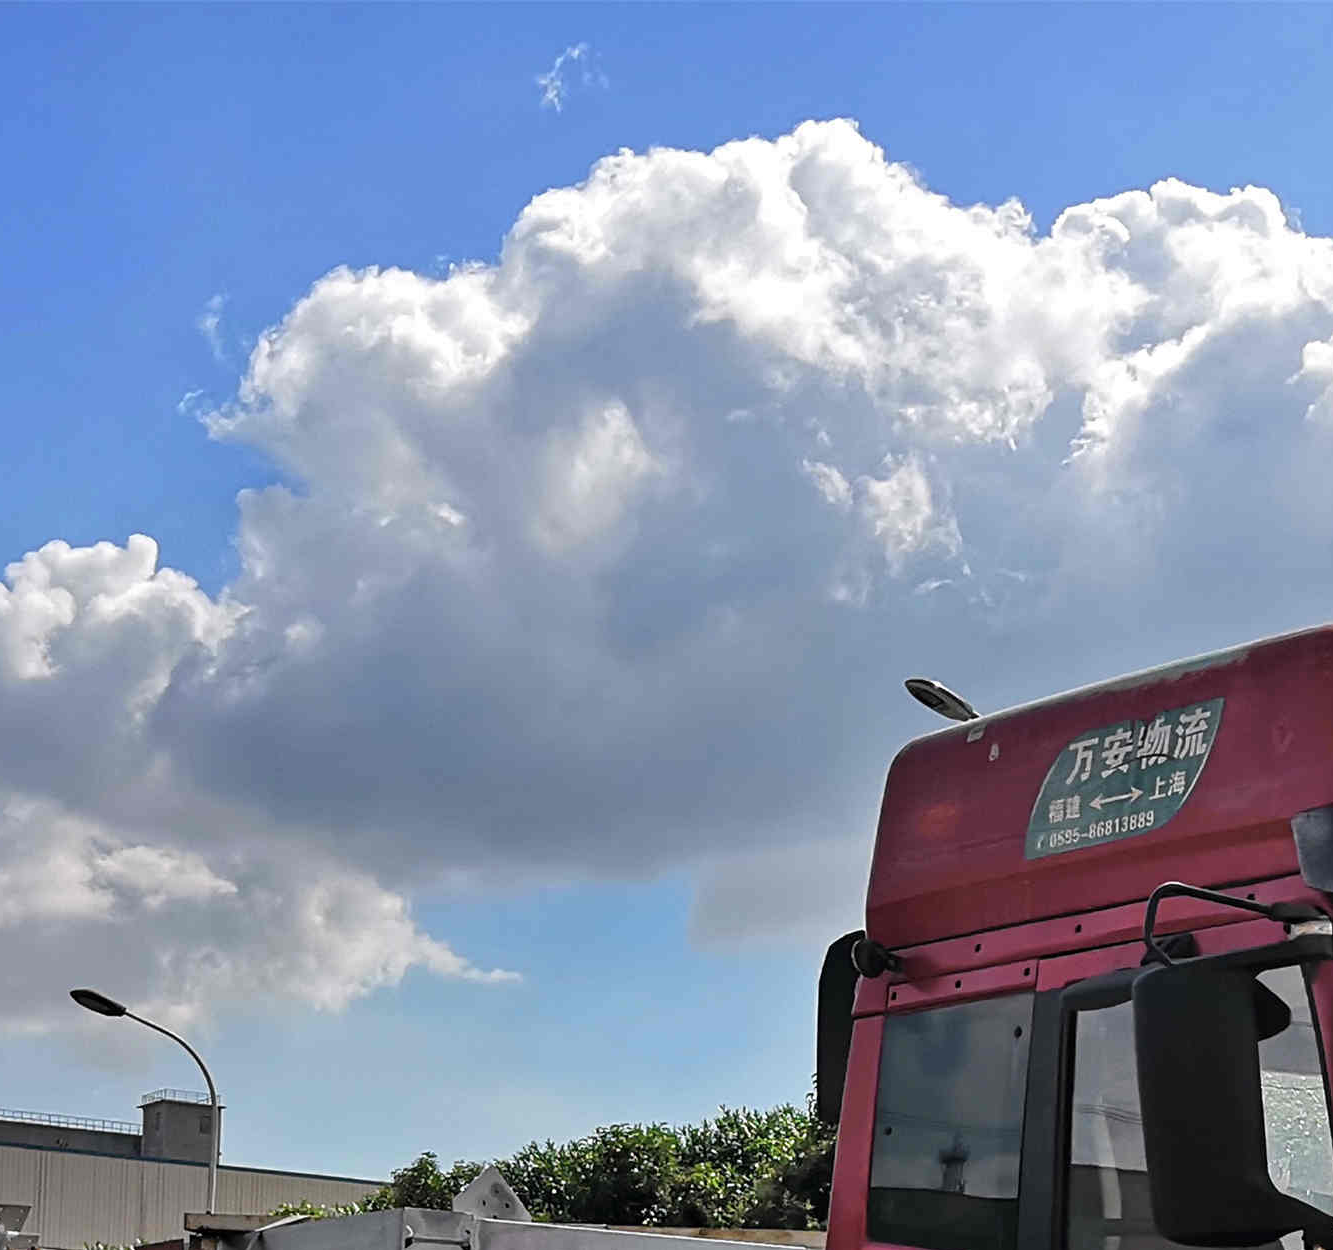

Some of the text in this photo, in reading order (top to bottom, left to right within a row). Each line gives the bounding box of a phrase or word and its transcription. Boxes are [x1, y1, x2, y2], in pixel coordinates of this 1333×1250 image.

[1067, 708, 1212, 785] 万安物流
[1048, 770, 1186, 824] 福建 上海
